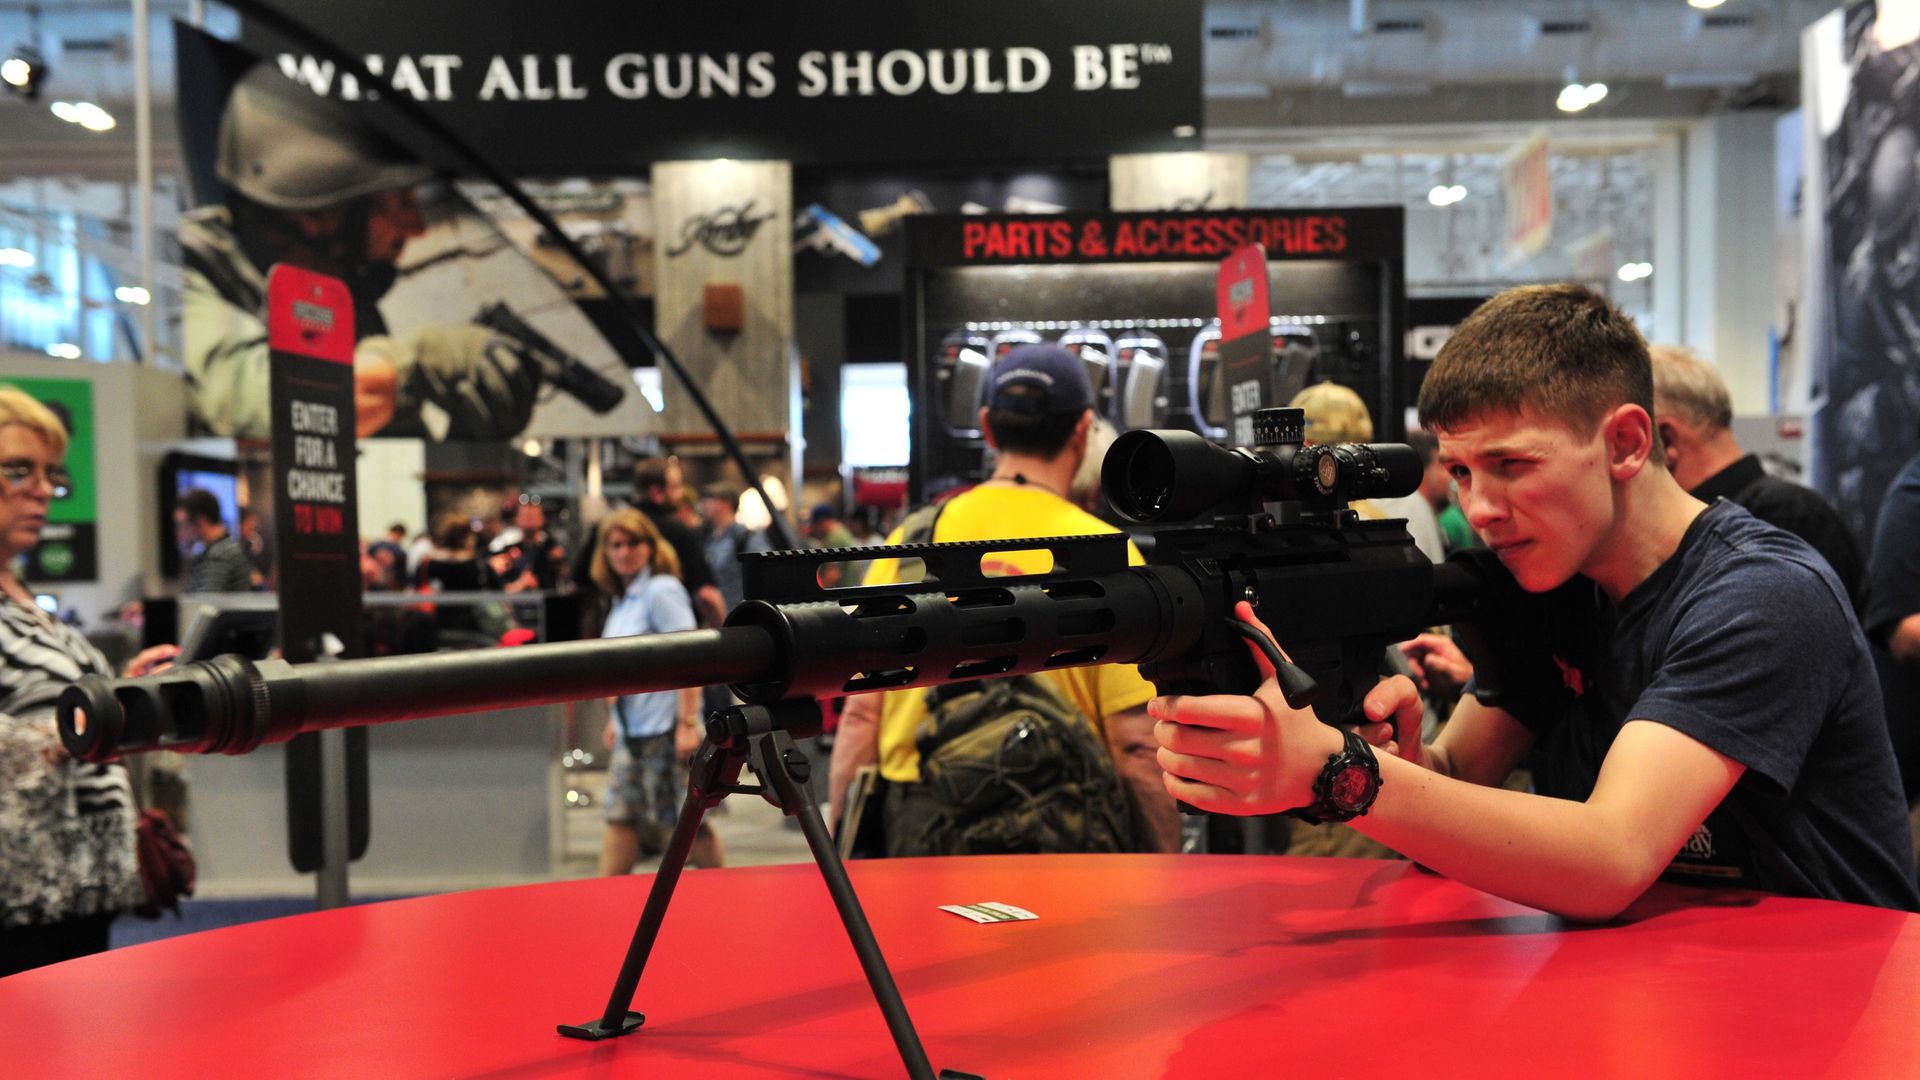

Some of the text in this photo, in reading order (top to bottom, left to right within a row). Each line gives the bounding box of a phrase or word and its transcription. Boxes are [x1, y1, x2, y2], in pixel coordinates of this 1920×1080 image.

[479, 54, 588, 100] ALL
[604, 51, 776, 99] GUNS
[797, 46, 1052, 97] SHOULD
[963, 215, 1348, 258] PARTS & ACCESSORIES
[291, 400, 339, 436] ENTER
[295, 435, 338, 469] FOR A
[287, 467, 346, 503] CHANCE
